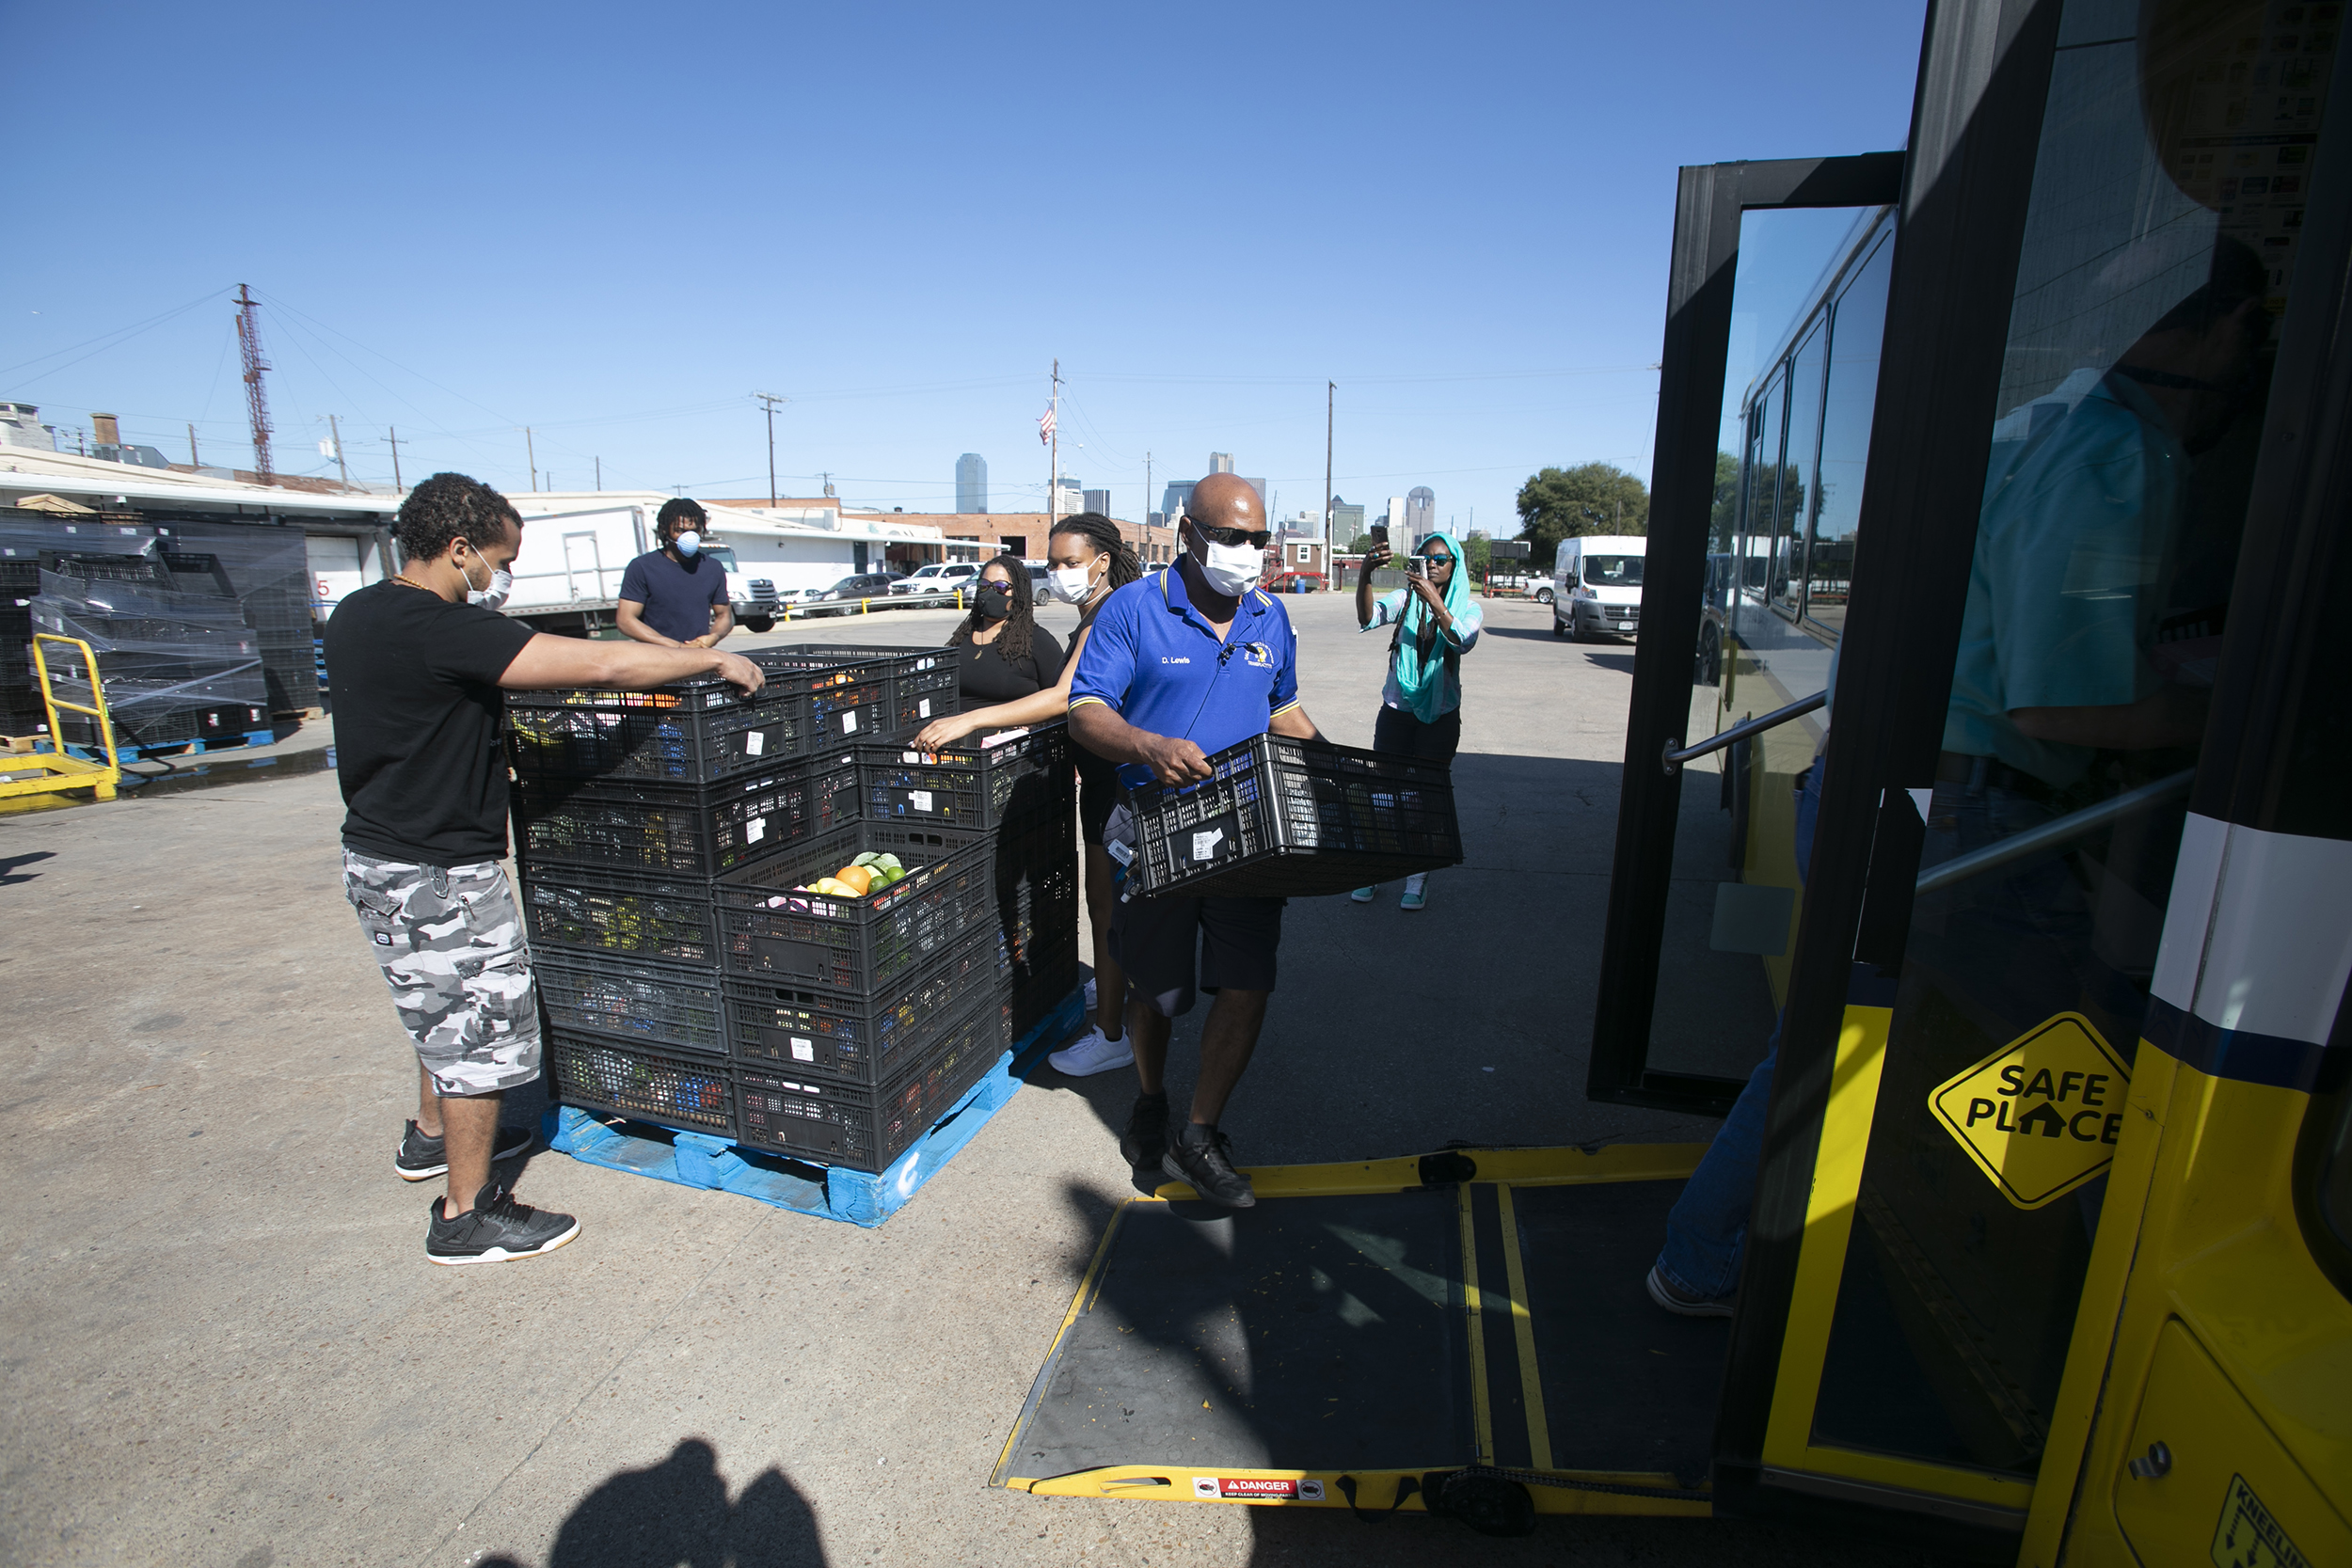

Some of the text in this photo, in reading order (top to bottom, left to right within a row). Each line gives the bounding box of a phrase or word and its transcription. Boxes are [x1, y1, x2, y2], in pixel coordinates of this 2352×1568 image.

[317, 579, 329, 596] 5
[1996, 1065, 2109, 1106] SAFE
[1239, 1481, 1290, 1491] DANGER
